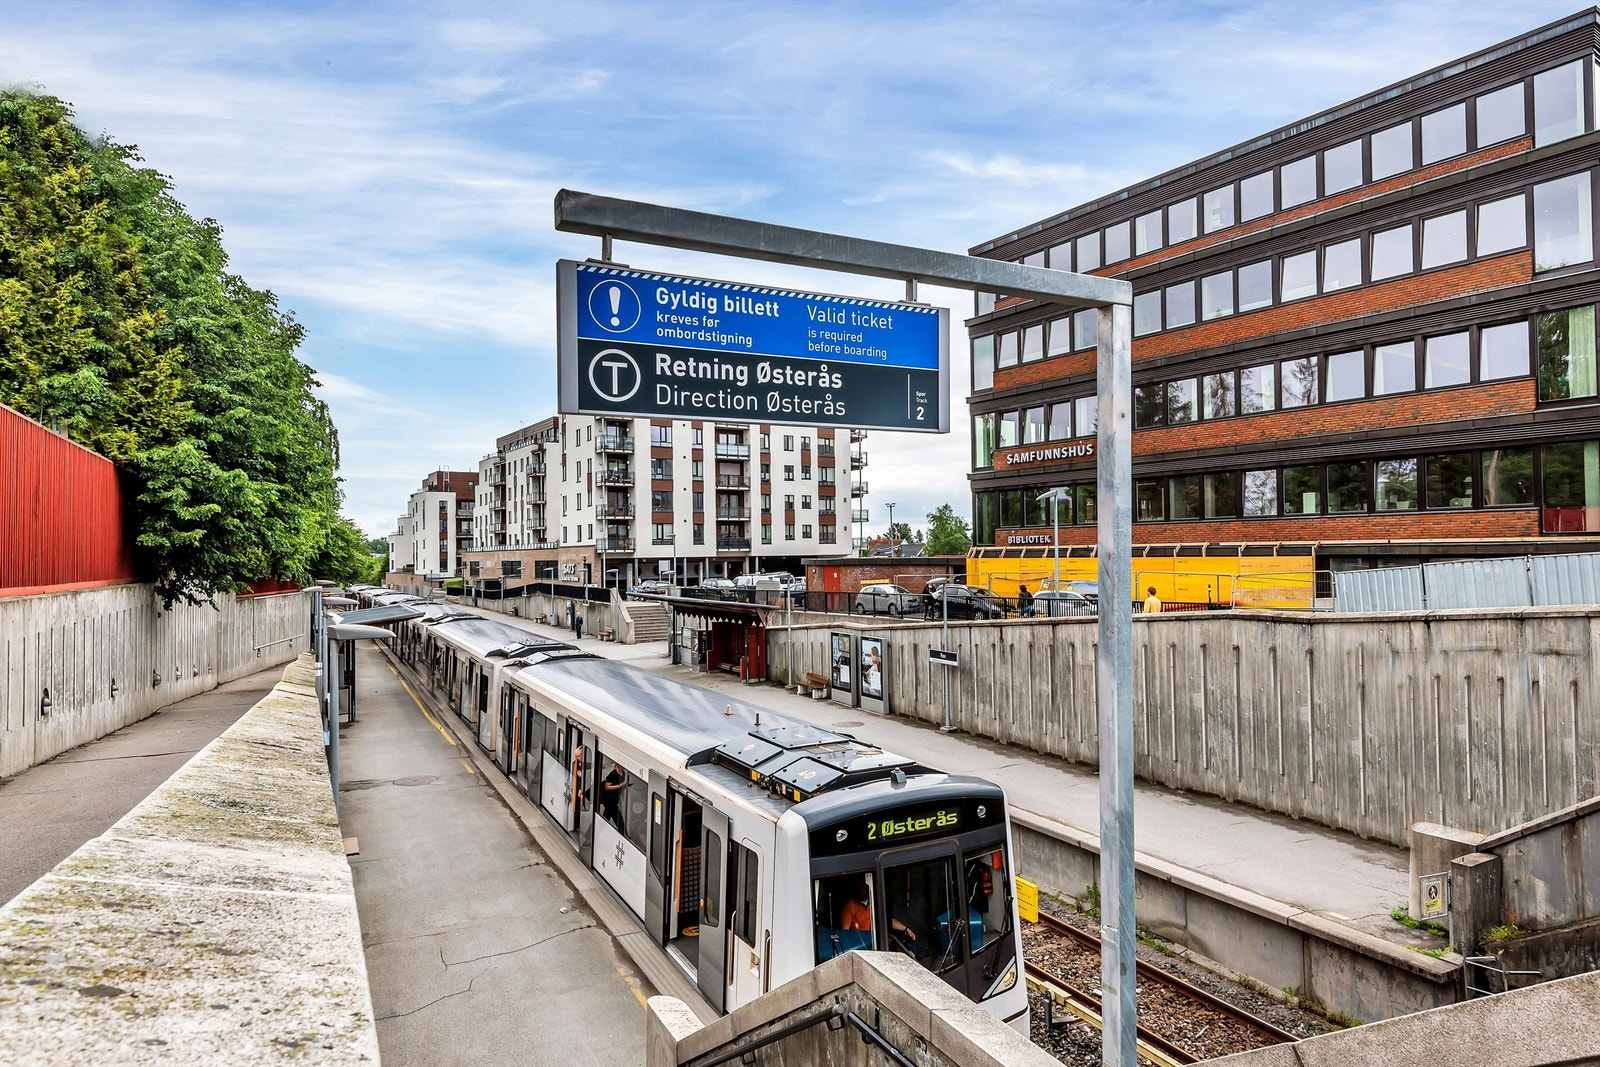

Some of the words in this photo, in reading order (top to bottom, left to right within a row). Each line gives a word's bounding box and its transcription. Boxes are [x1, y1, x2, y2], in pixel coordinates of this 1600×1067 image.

[656, 287, 718, 314] Gyldig
[724, 295, 780, 318] billett
[656, 311, 699, 326] kreves
[702, 315, 720, 328] før
[807, 305, 846, 325] Valid
[851, 311, 893, 329] ticket
[656, 327, 753, 347] ombordstigning
[808, 327, 817, 338] is
[820, 330, 863, 343] required
[808, 341, 841, 353] before
[844, 344, 887, 360] boarding
[655, 353, 748, 387] Retning
[756, 361, 843, 389] Østerås
[656, 383, 758, 411] Direction
[766, 391, 846, 416] Østerås
[916, 406, 925, 421] 2
[1006, 443, 1094, 465] SAMFUNNSHUS
[1007, 534, 1051, 544] BIBLIOTEK
[867, 821, 877, 840] 2
[881, 810, 958, 837] Østerås
